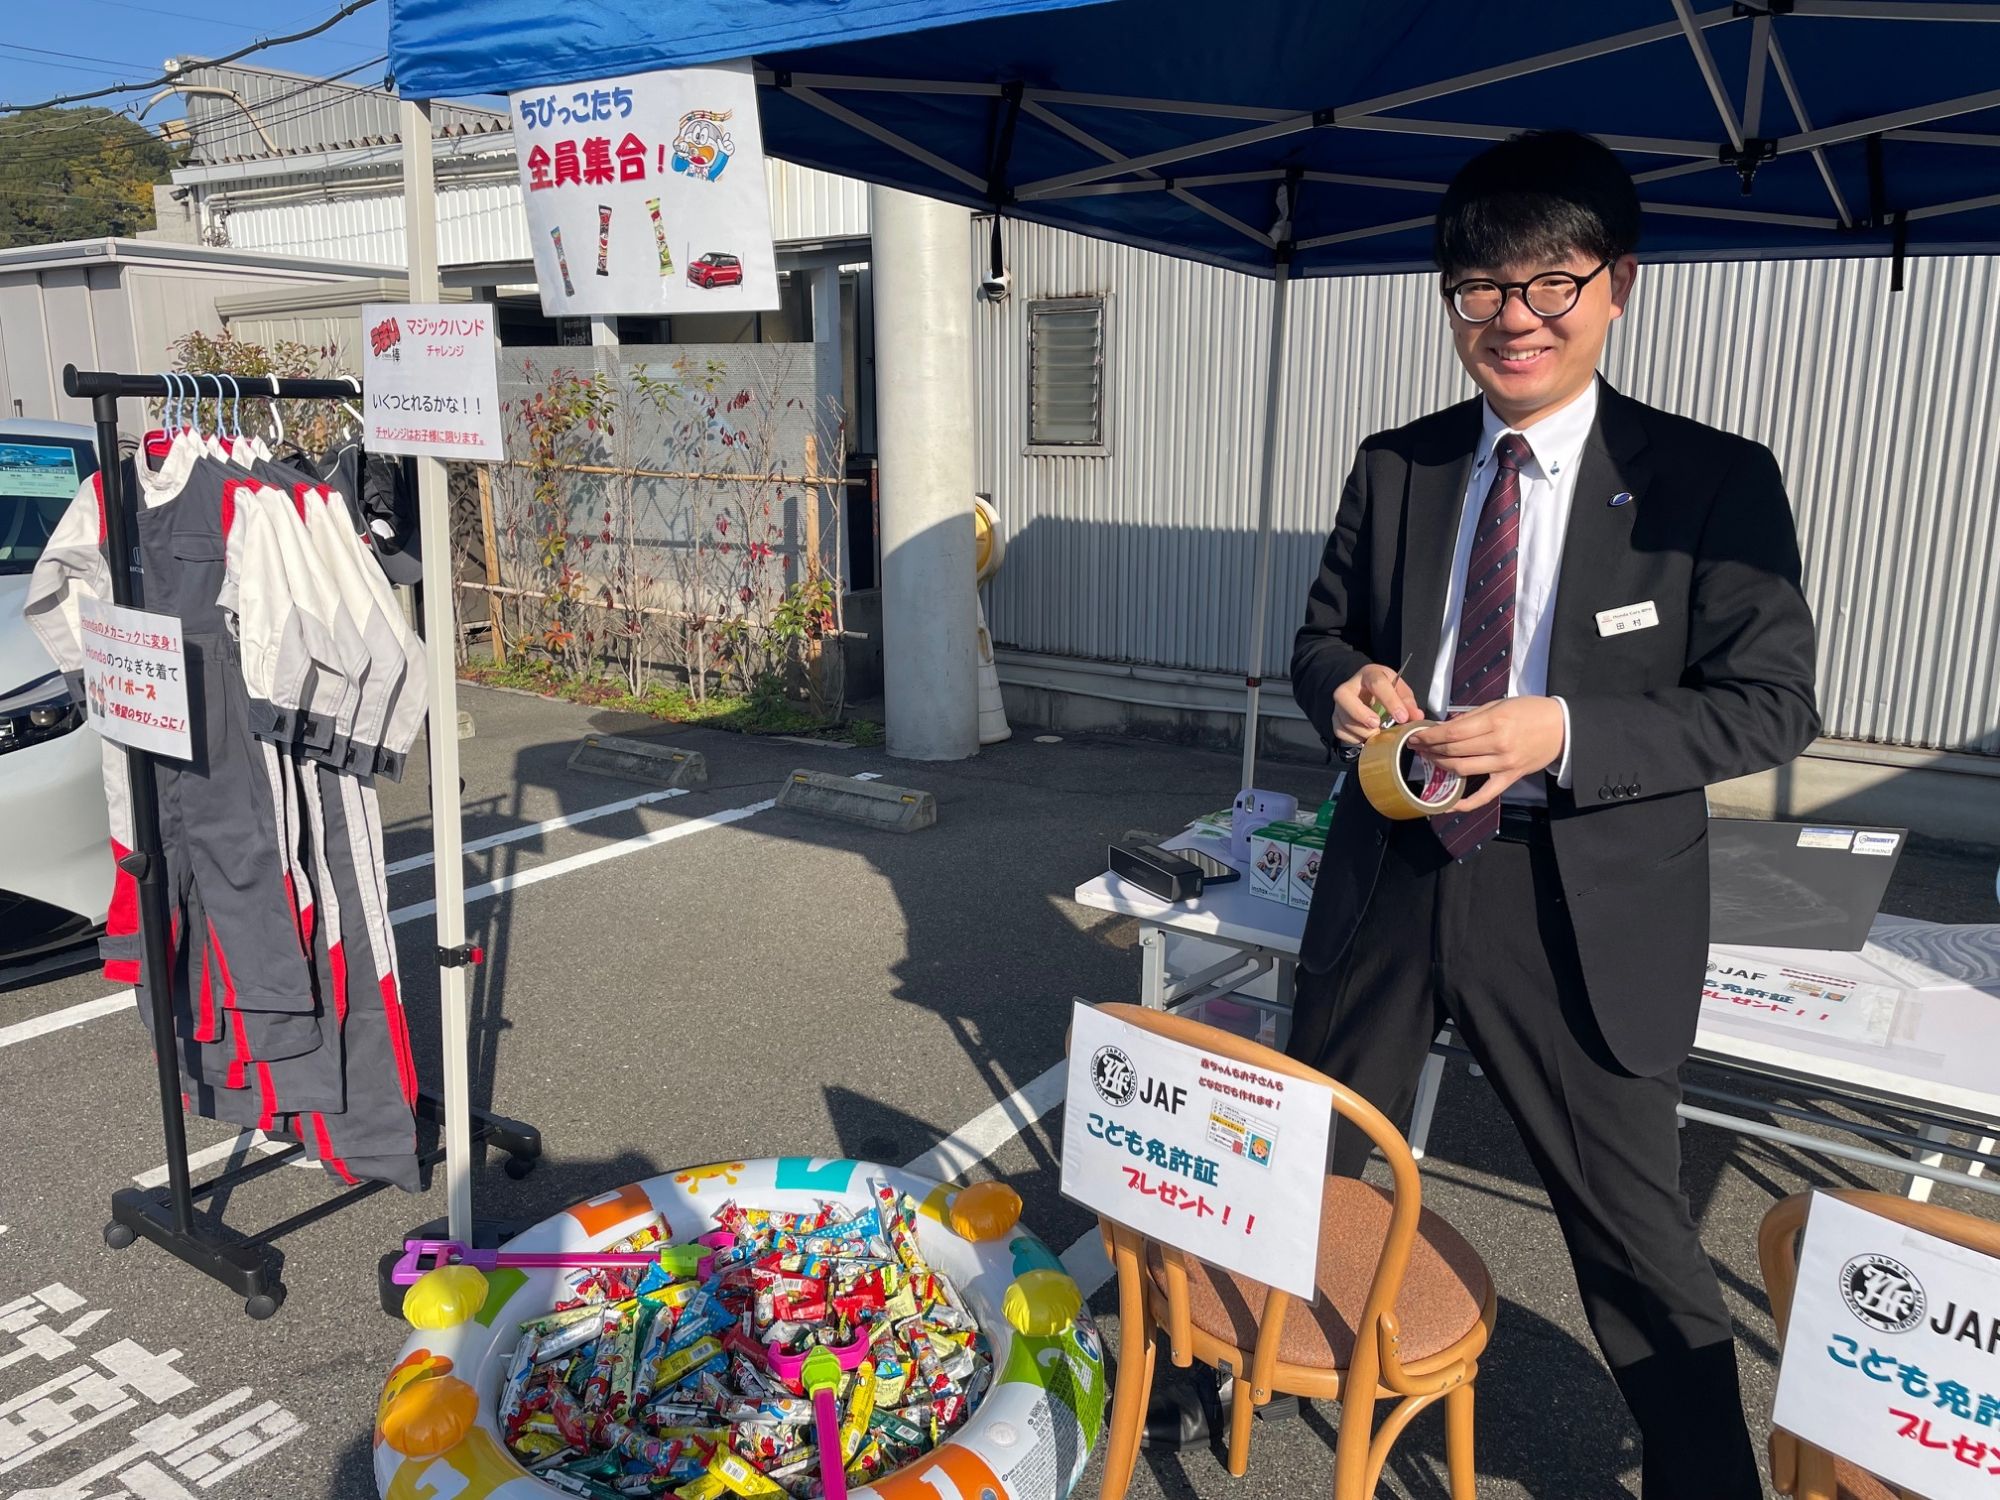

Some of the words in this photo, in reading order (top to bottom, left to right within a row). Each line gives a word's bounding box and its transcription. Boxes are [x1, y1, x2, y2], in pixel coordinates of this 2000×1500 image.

[519, 86, 634, 130] ちびっこたち
[406, 318, 485, 337] マジックハンド
[426, 344, 464, 357] チャレンジ
[372, 393, 481, 415] いくつとれるかな！！
[375, 426, 486, 446] チャレンジはお子様に限ります。
[85, 643, 179, 682] Hondaのつなぎを着て
[1718, 967, 1767, 981] JAF
[1140, 1077, 1187, 1115] JAF
[1087, 1112, 1219, 1187] こども免許証
[1122, 1166, 1256, 1235] プレゼント！！
[1868, 1256, 1910, 1278] JAPAN
